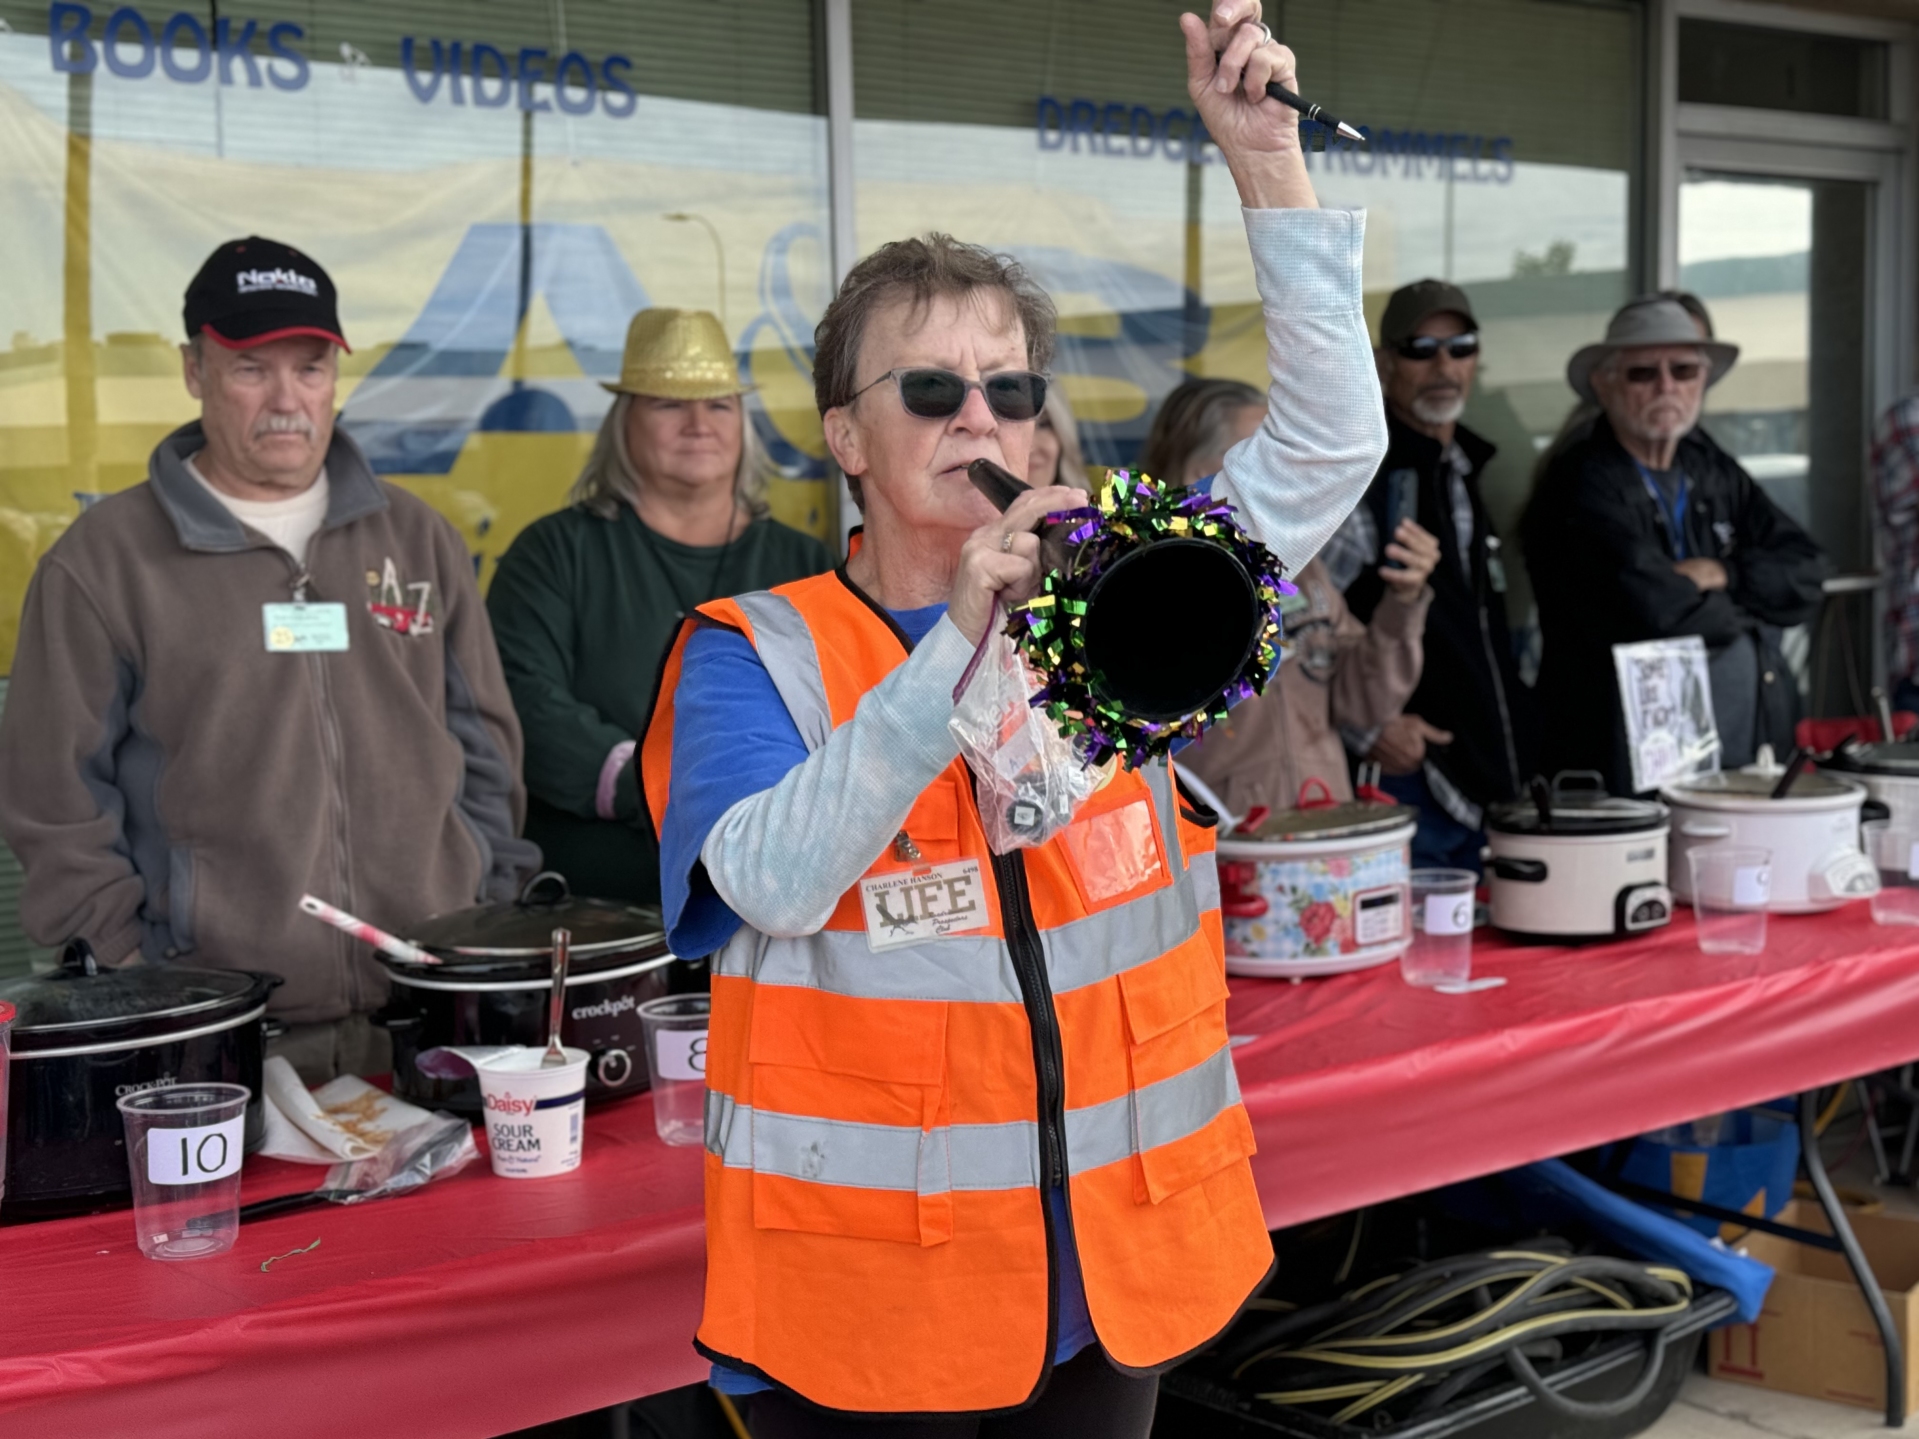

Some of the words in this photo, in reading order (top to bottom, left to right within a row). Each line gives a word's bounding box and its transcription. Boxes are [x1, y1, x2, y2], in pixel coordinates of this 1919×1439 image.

[49, 1, 310, 91] BOOKS
[401, 36, 637, 119] VIDEOS
[865, 879, 909, 892] CHARLENE
[910, 872, 943, 884] HANSON
[874, 875, 977, 928] LIFE
[1452, 901, 1471, 929] 6
[571, 995, 635, 1020] crockpot
[486, 1092, 534, 1117] Daisy
[493, 1123, 534, 1138] SOUR
[181, 1132, 228, 1176] 10
[491, 1137, 541, 1152] CREAM
